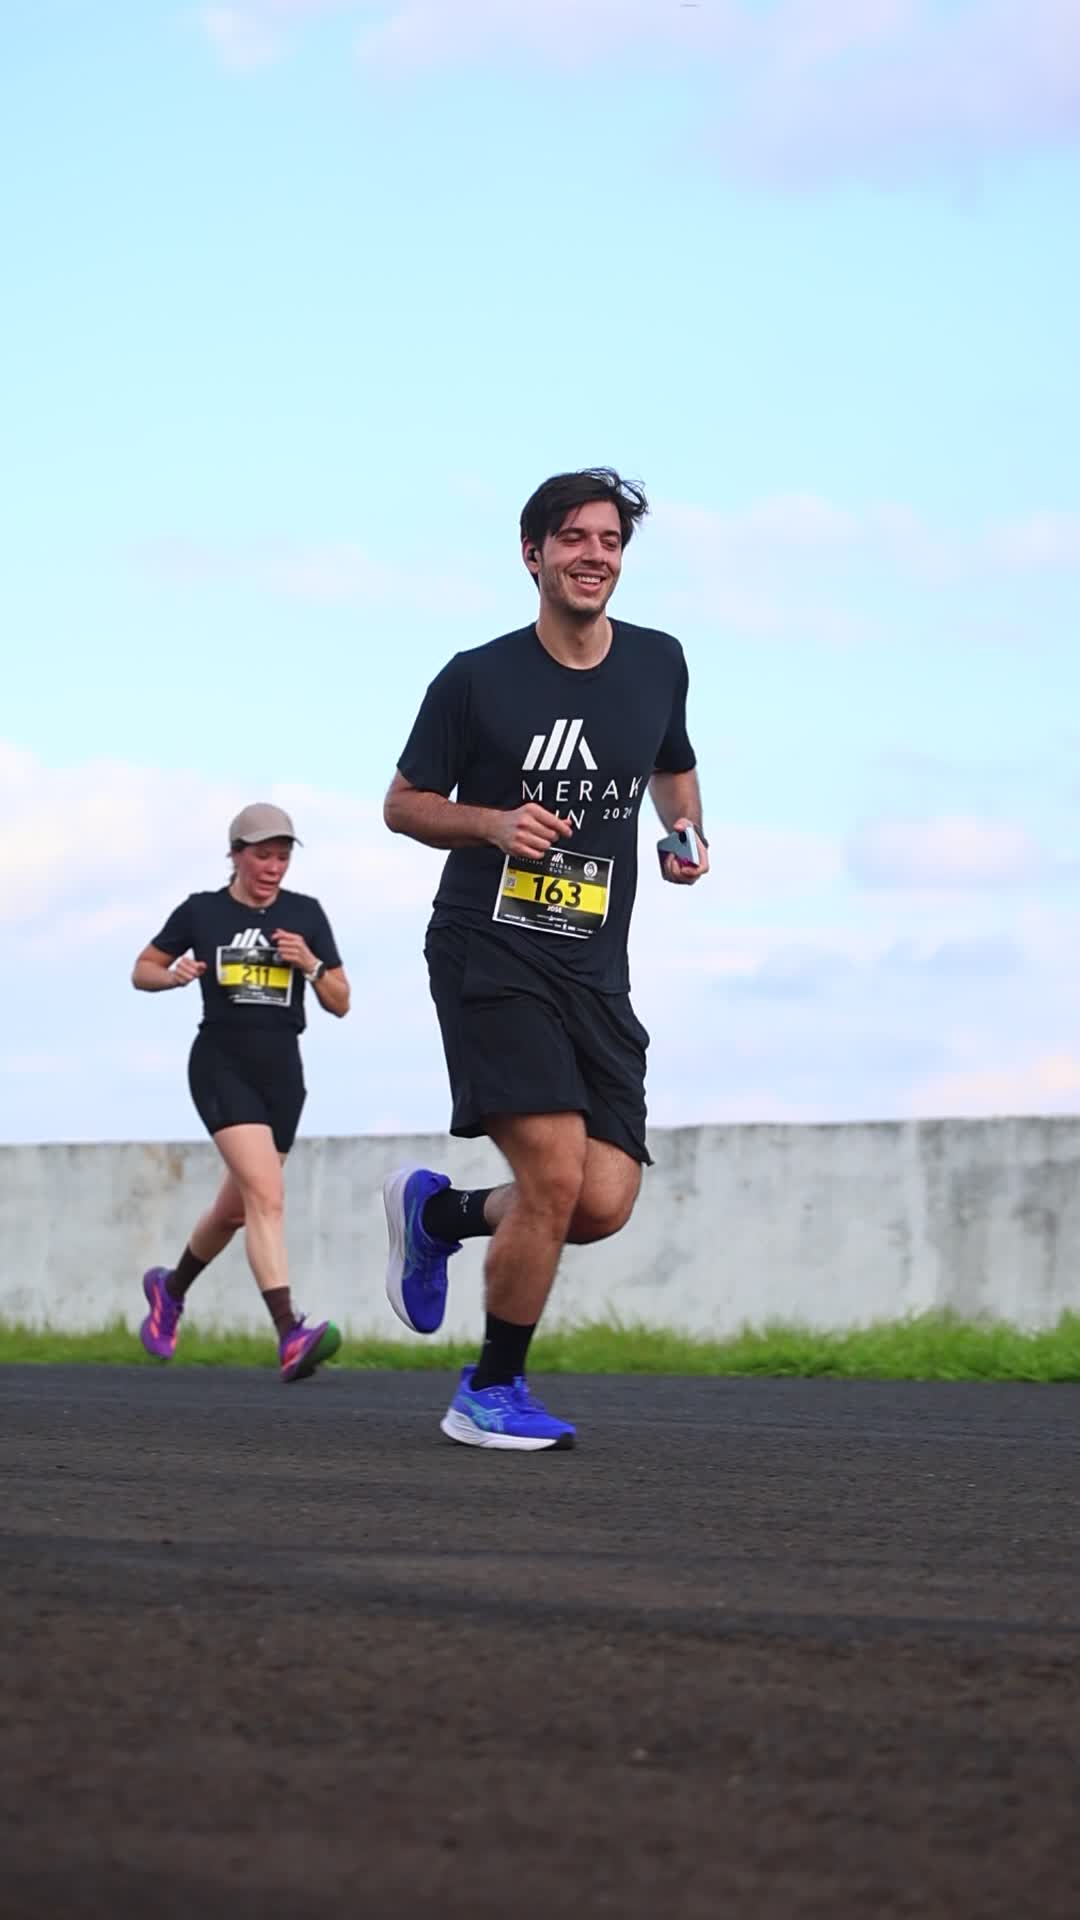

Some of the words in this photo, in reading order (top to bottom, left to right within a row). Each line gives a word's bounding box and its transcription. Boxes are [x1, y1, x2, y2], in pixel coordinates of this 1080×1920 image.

[522, 776, 642, 802] MERAK
[533, 876, 582, 908] 163
[242, 966, 269, 986] 211
